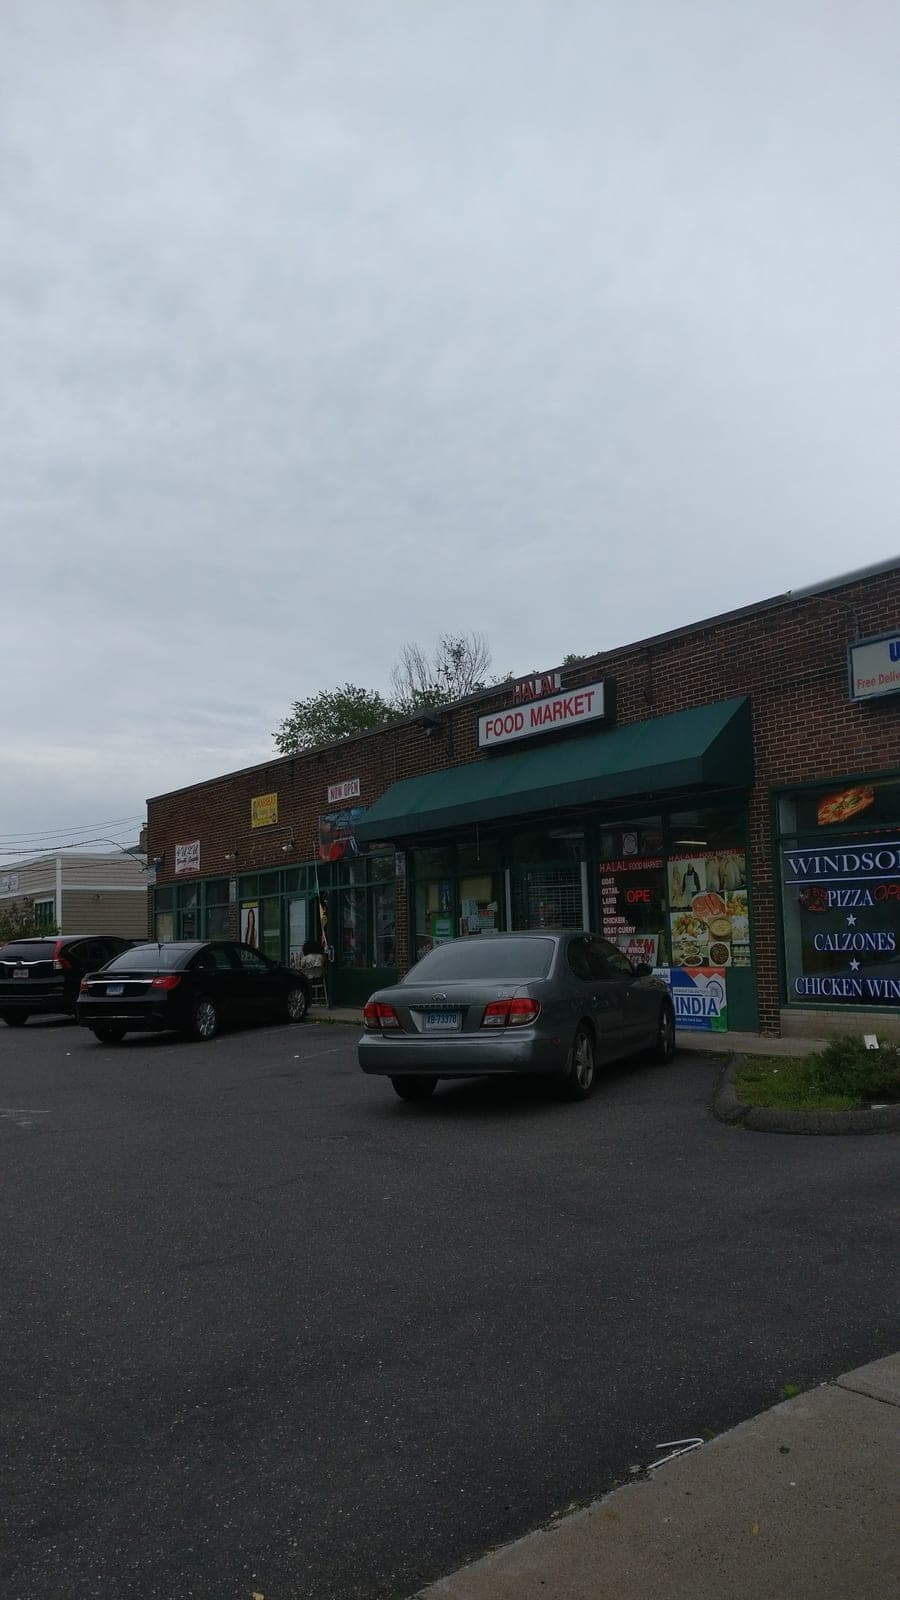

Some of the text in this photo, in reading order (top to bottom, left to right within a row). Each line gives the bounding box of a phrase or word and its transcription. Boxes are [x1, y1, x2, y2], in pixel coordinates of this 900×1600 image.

[512, 673, 561, 704] HALAL
[857, 678, 876, 689] Free
[485, 691, 595, 739] FOOD MARKET
[330, 781, 359, 800] NOW OPEN
[643, 859, 663, 870] MARKET
[788, 850, 900, 875] WINDSO
[602, 897, 617, 905] LAMB
[828, 889, 874, 907] PIZZA
[603, 907, 617, 915] VEAL
[603, 916, 626, 924] CHICKEN
[618, 926, 636, 934] CURRY
[814, 932, 896, 951] CALZONES
[795, 977, 863, 997] CHICKEN
[676, 996, 719, 1016] INDIA
